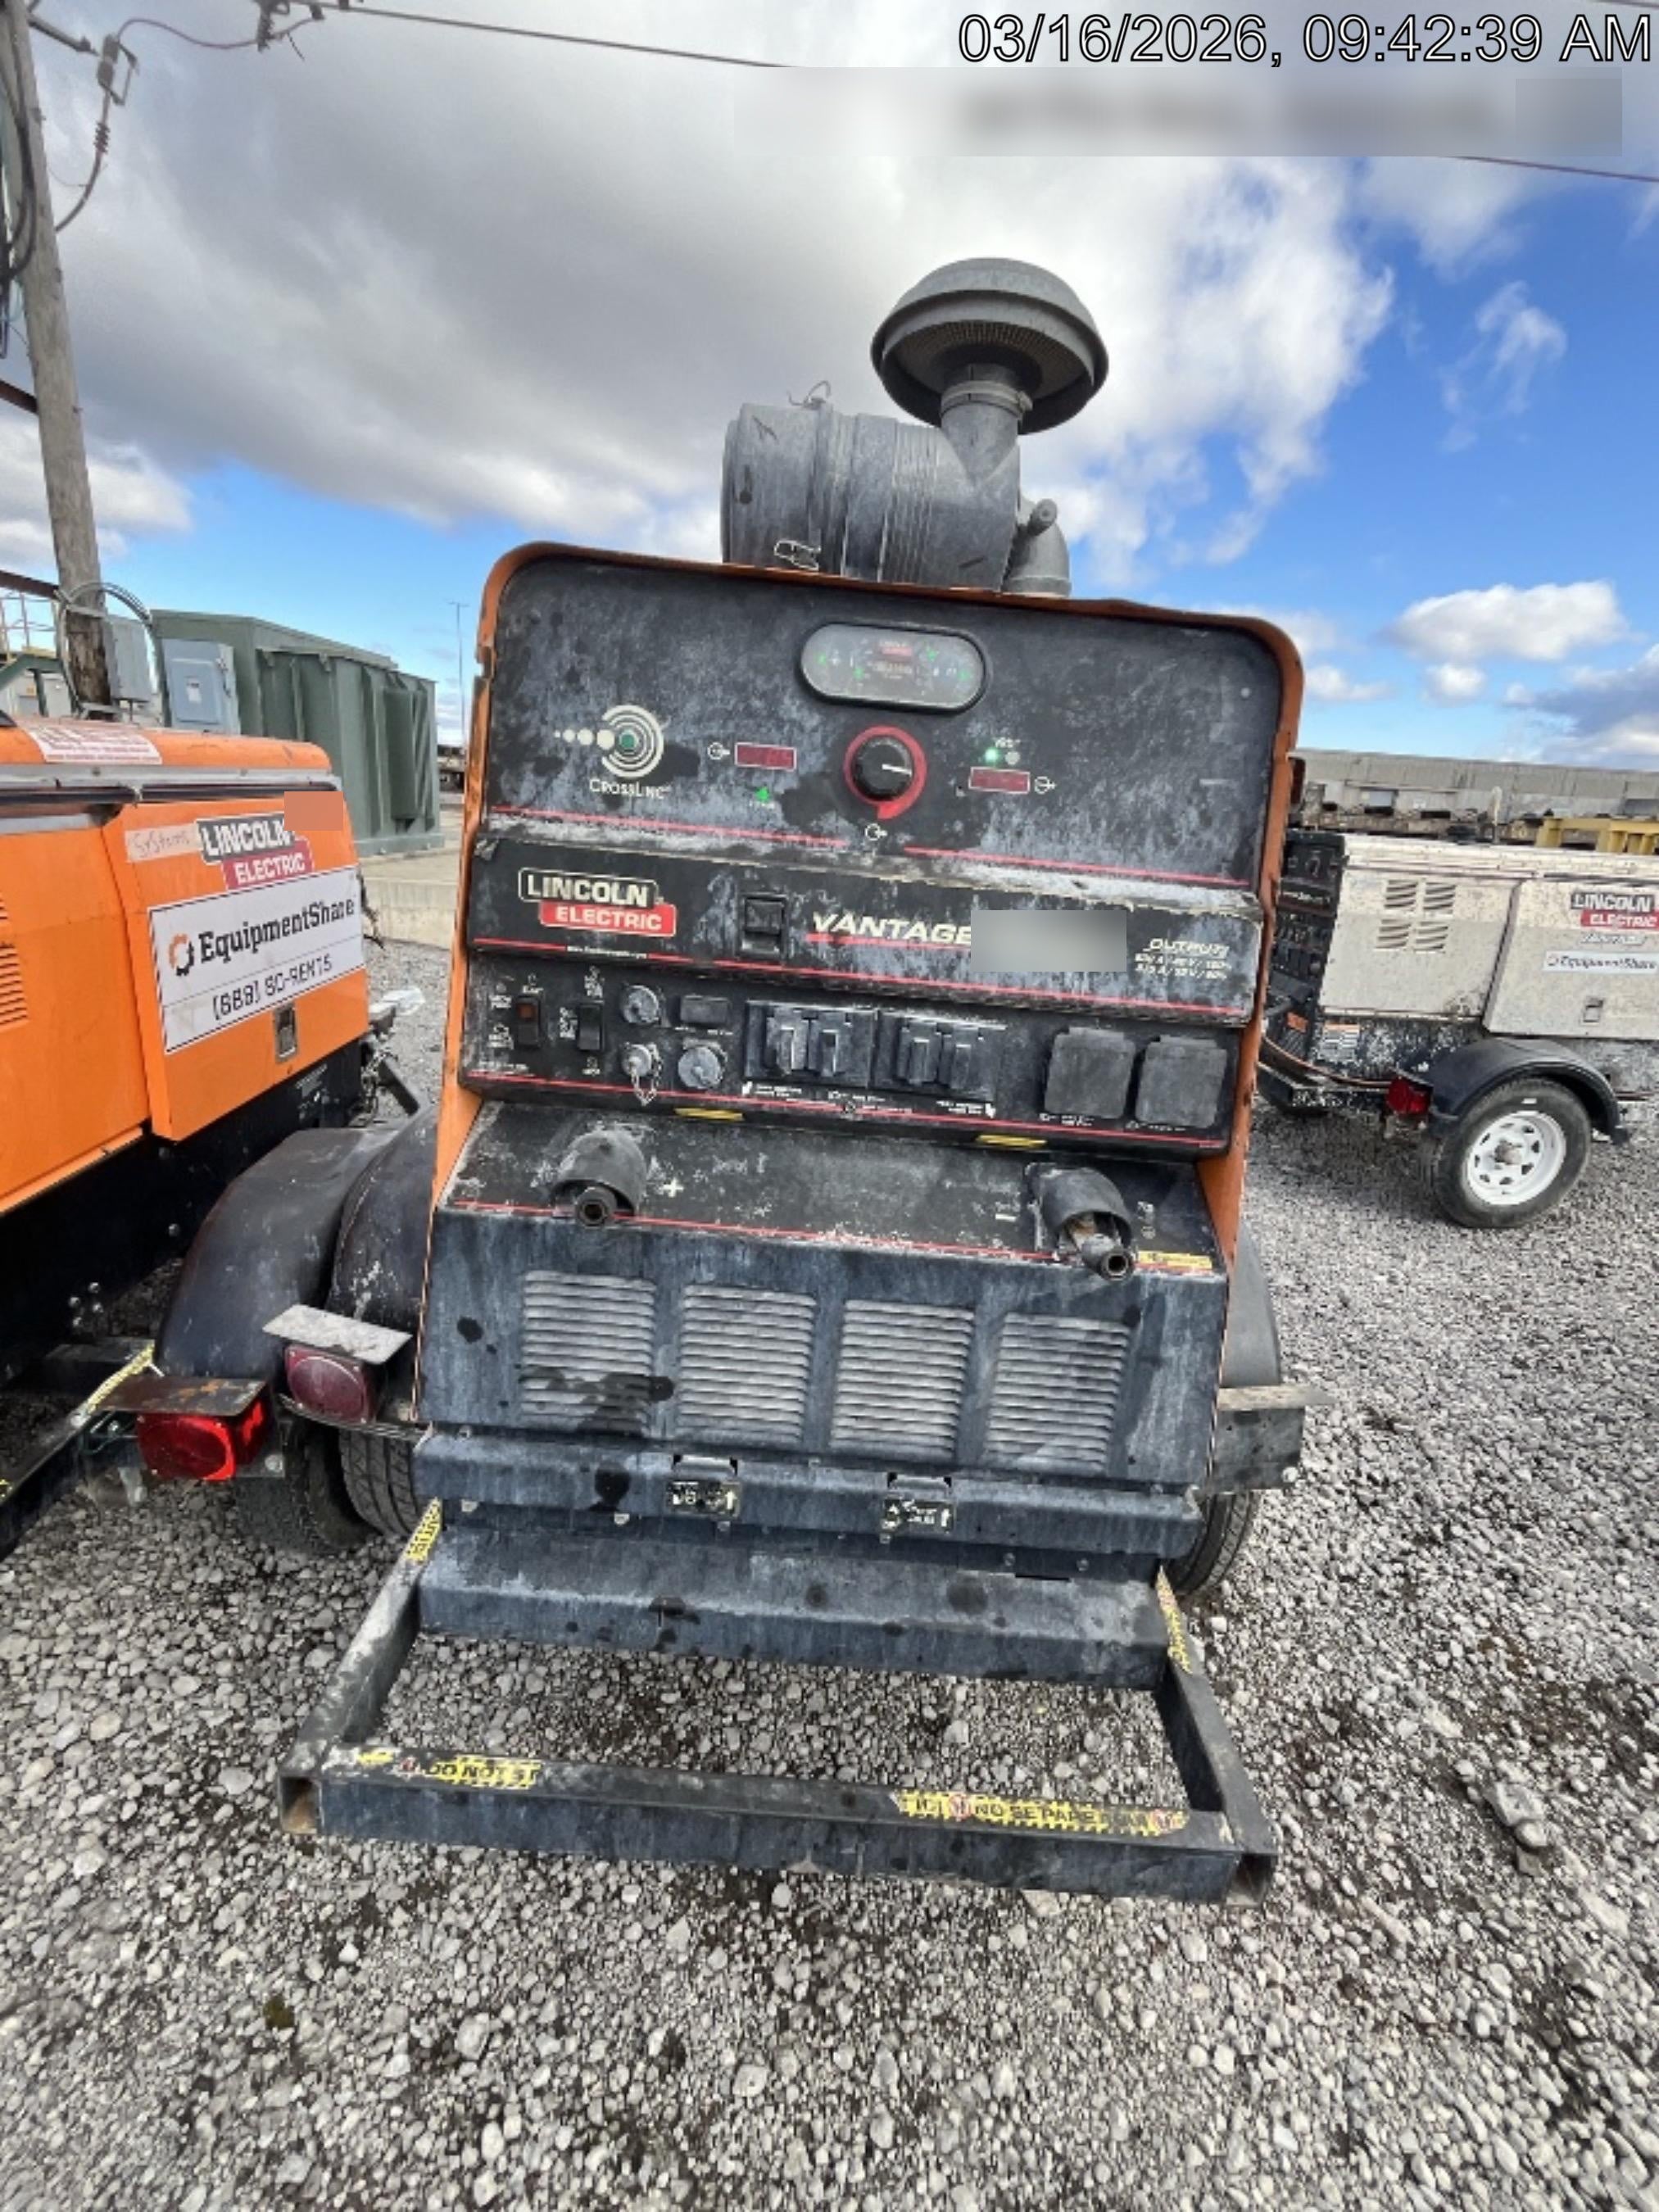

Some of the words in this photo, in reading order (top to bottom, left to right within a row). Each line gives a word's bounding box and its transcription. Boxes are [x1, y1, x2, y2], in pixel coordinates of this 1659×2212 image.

[202, 820, 291, 854] LINCOLN
[234, 853, 306, 885] ELECTRIC
[527, 874, 649, 907] LINCOLN
[1573, 893, 1651, 912] LINCOLN
[198, 899, 355, 963] EquipmentShare
[555, 905, 662, 930] ELECTRIC
[813, 911, 972, 945] VANTAGE
[1589, 913, 1657, 927] ELECTRIC
